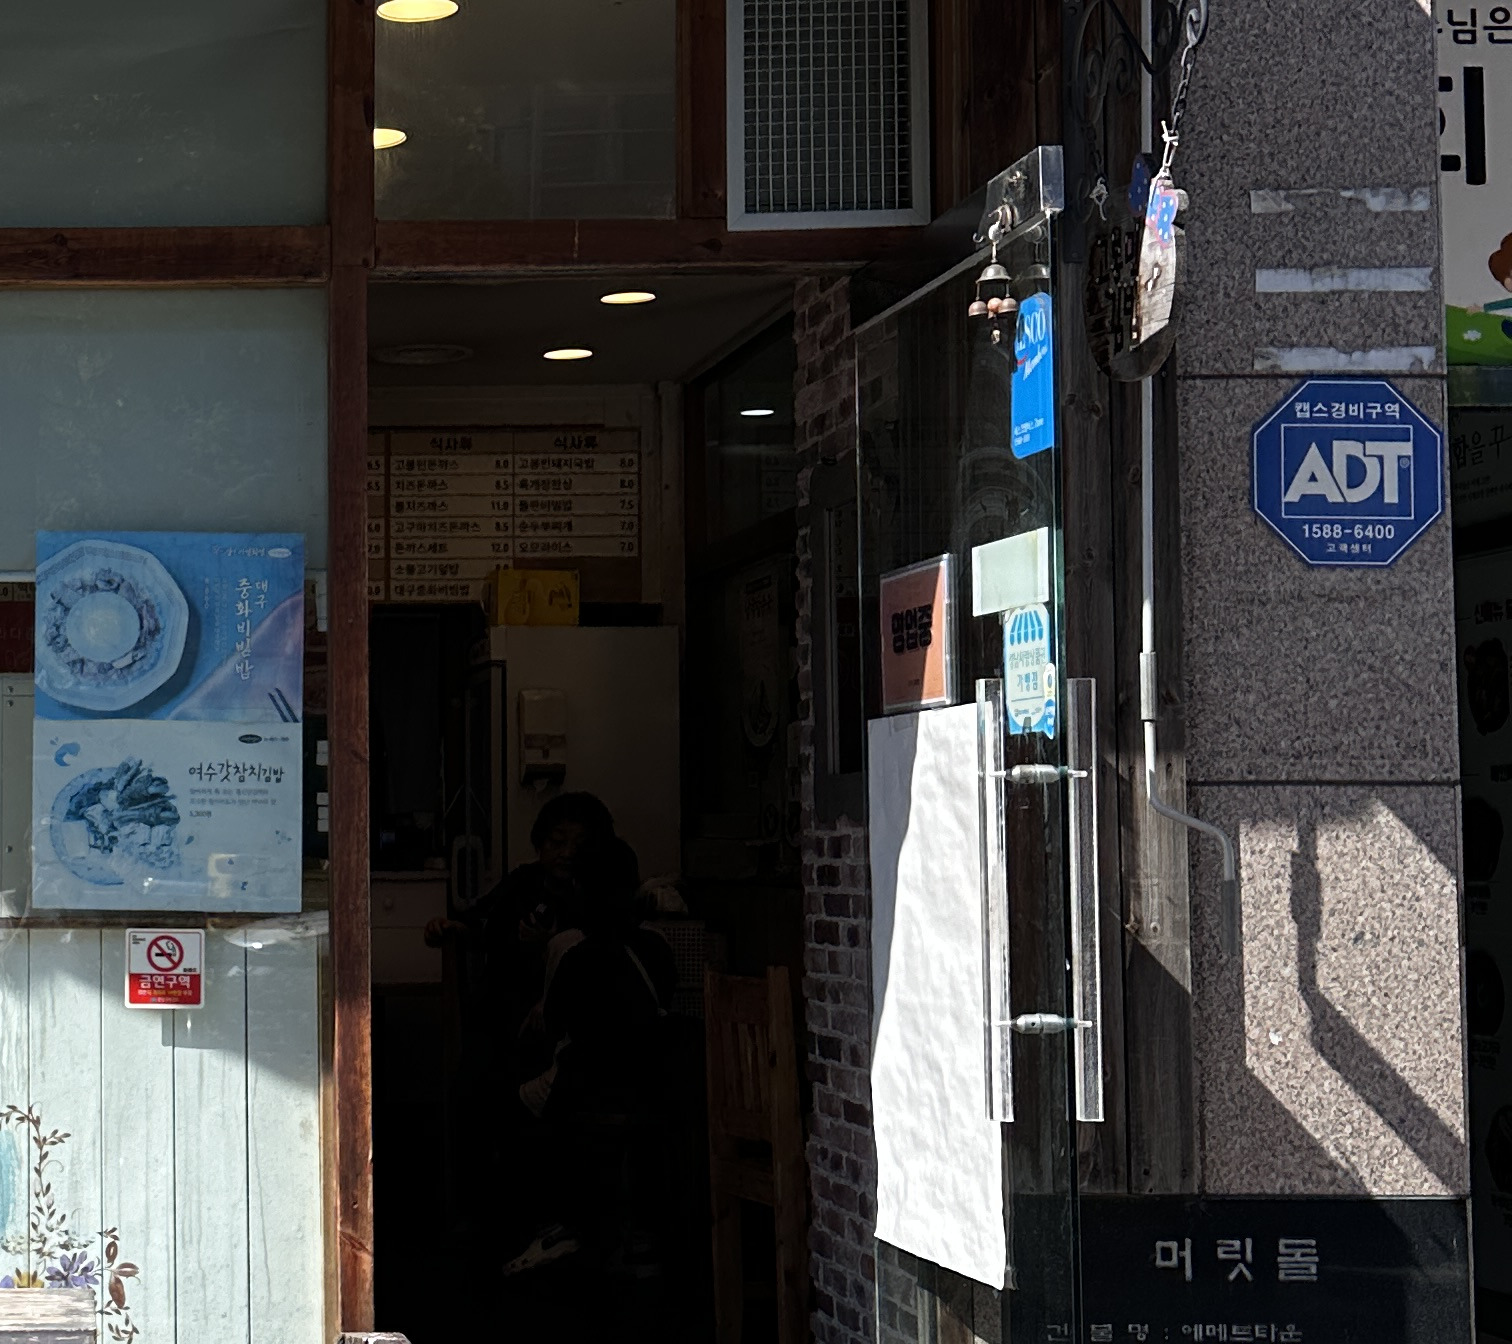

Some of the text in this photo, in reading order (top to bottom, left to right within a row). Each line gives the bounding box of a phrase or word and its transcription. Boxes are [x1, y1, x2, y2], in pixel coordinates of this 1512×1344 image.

[1437, 6, 1512, 45] 님은
[1294, 401, 1401, 420] 캡스경비구역
[1283, 439, 1413, 504] ADT
[1302, 523, 1396, 539] 1588-6400
[1326, 542, 1372, 554] 고객센터
[254, 579, 269, 609] 대구
[234, 577, 255, 681] 중화비빔밥
[188, 758, 285, 784] 여수갓참치김밥
[138, 975, 191, 989] 금연구역
[1154, 1237, 1320, 1283] 머릿돌
